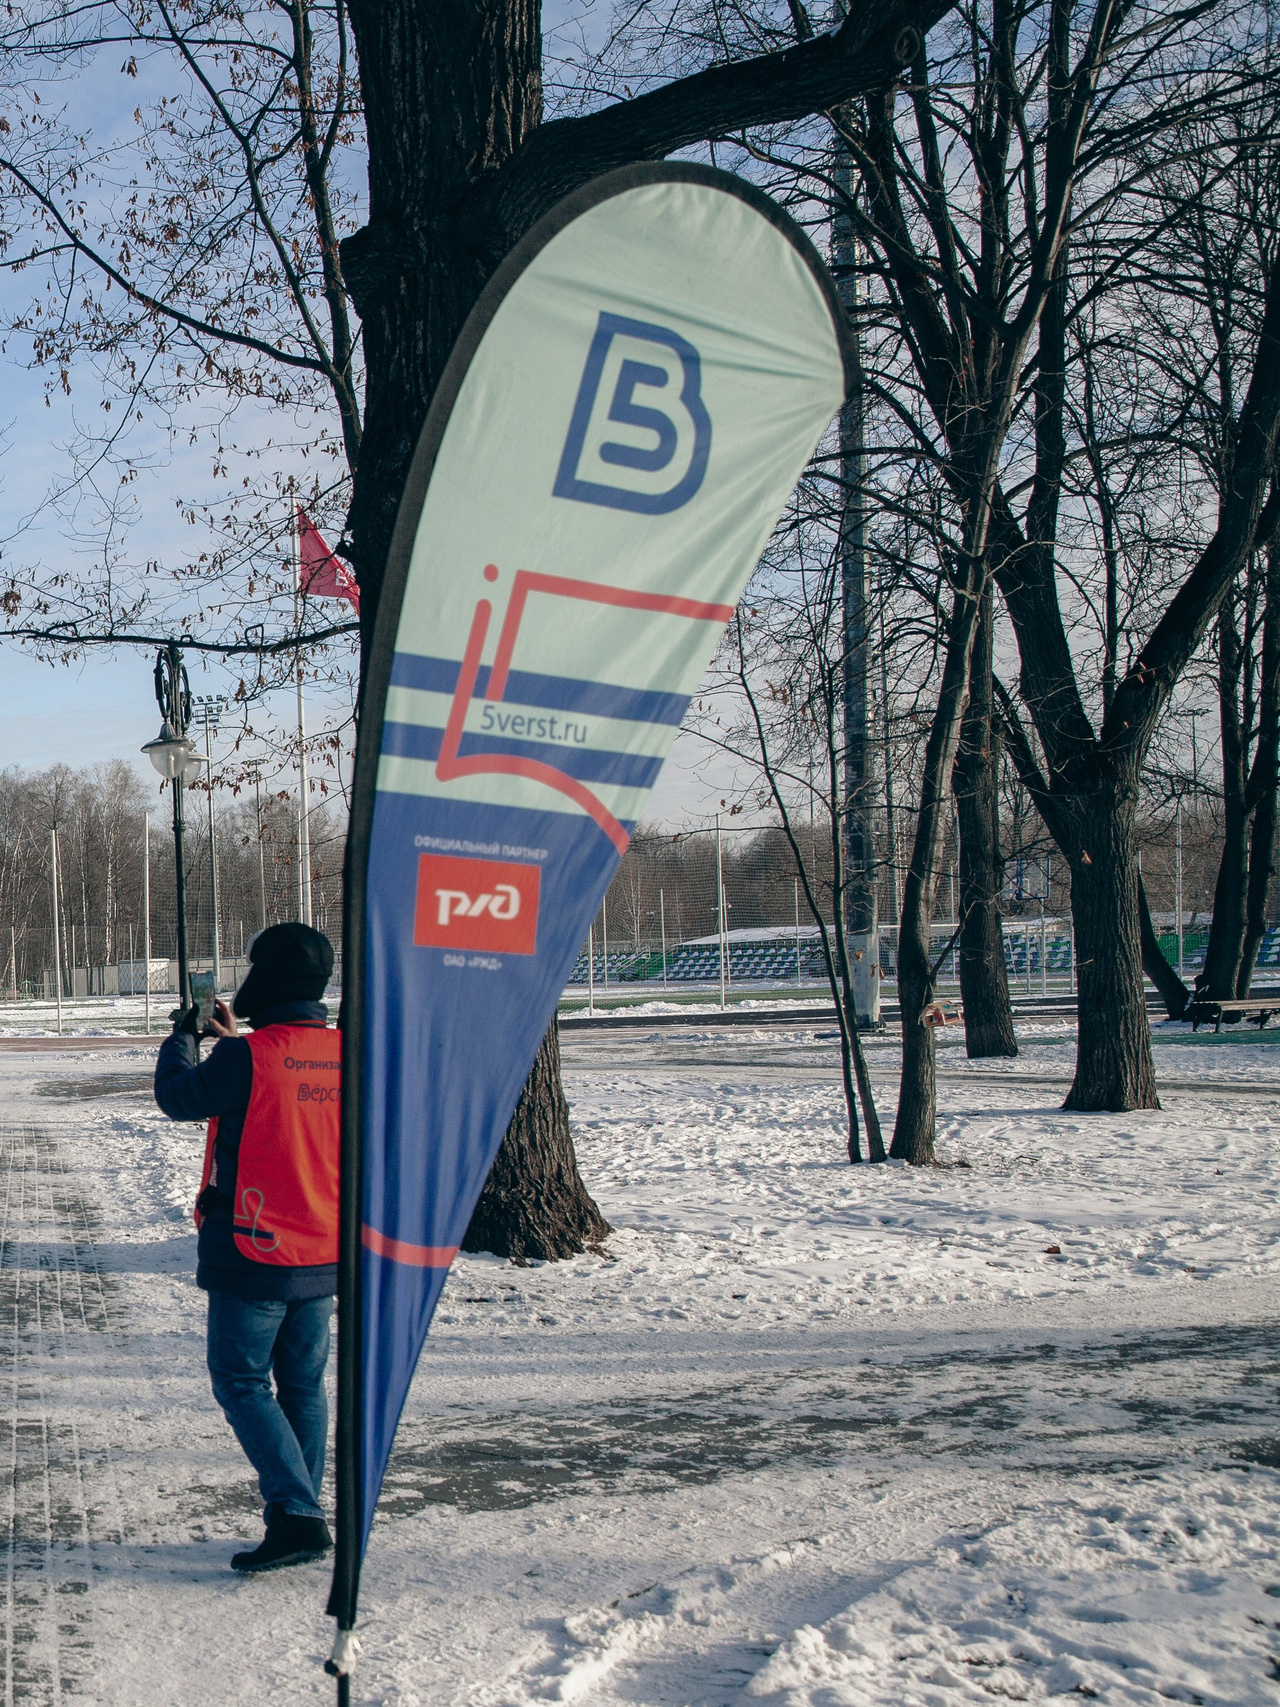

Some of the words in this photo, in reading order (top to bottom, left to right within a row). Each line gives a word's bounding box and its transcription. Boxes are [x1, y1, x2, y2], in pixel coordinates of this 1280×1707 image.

[480, 704, 587, 743] 5verst.ru
[414, 835, 500, 855] ОФИЦИАЛЬНЫЙ
[502, 844, 548, 860] ПАРТНЕР
[443, 953, 466, 967] ОАО
[284, 1057, 342, 1072] Организа
